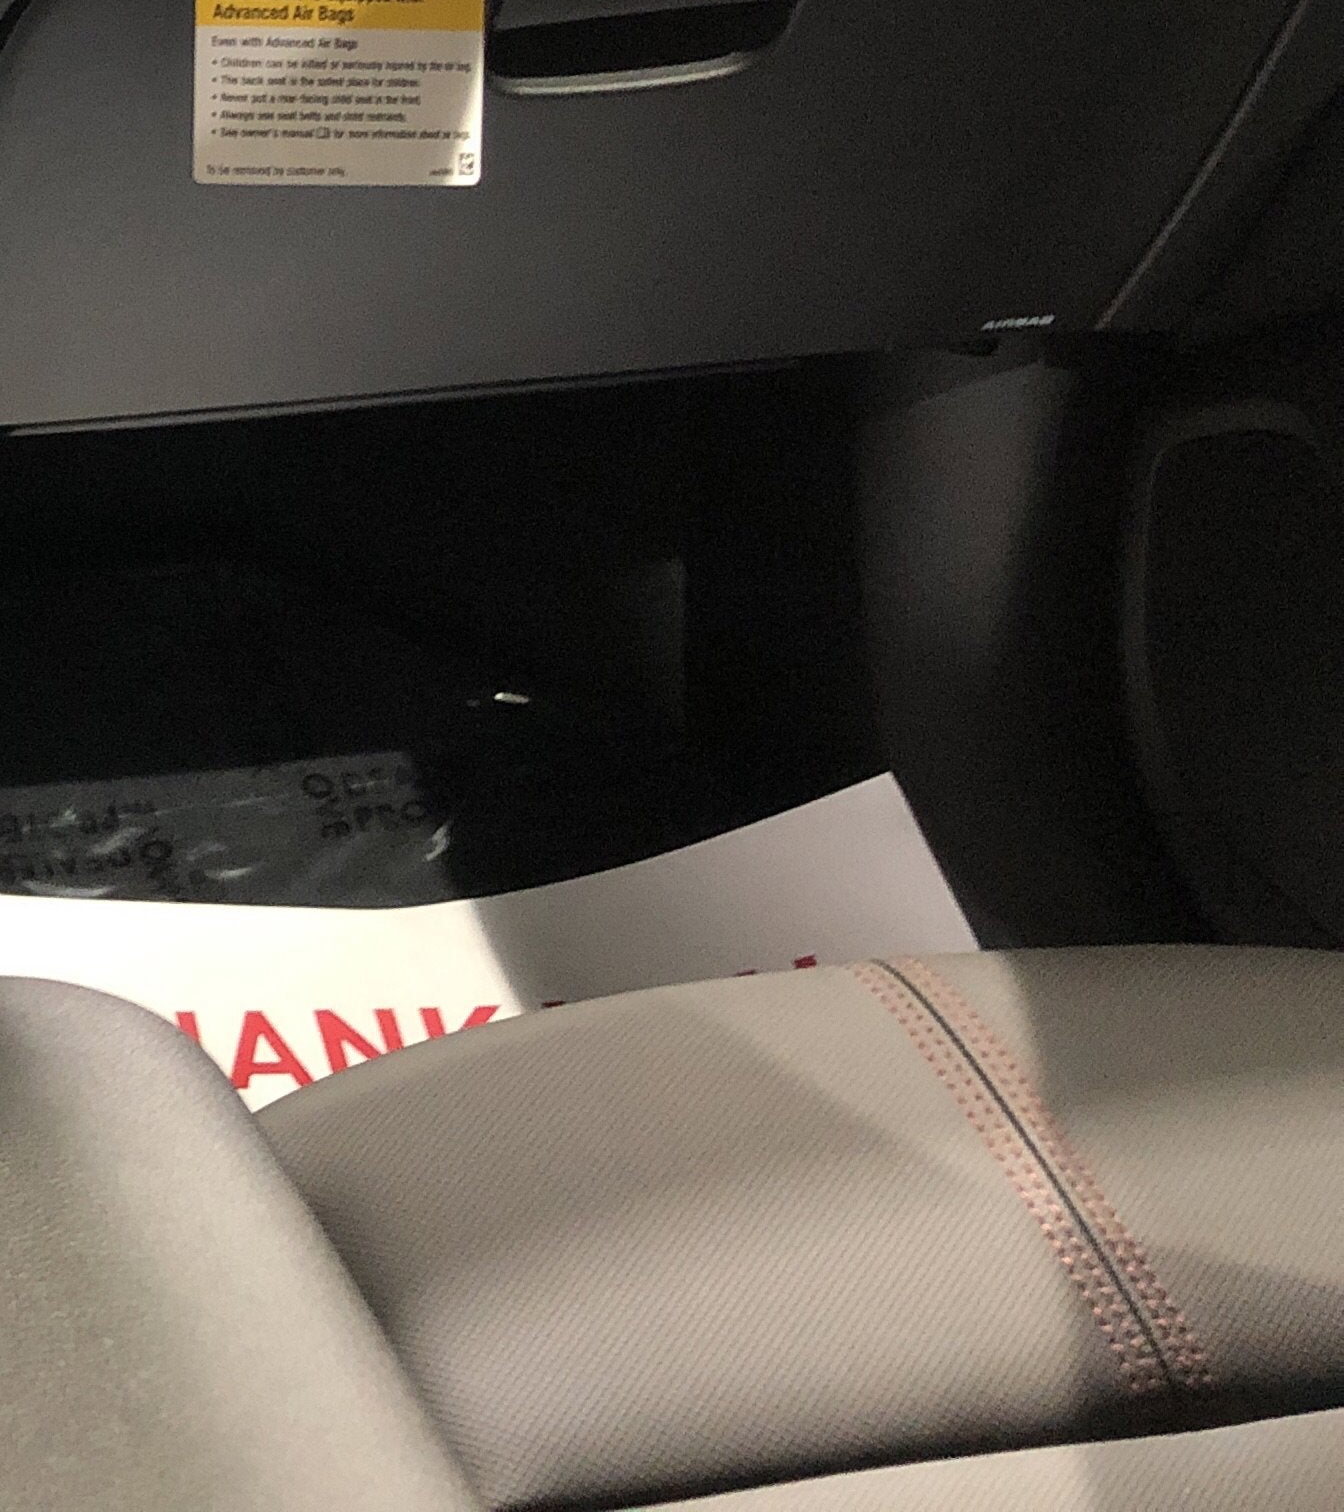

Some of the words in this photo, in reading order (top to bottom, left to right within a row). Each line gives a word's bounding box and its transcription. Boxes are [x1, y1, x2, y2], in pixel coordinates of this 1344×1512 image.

[213, 4, 289, 20] Advanced
[292, 5, 314, 20] Air
[318, 5, 355, 25] Bags
